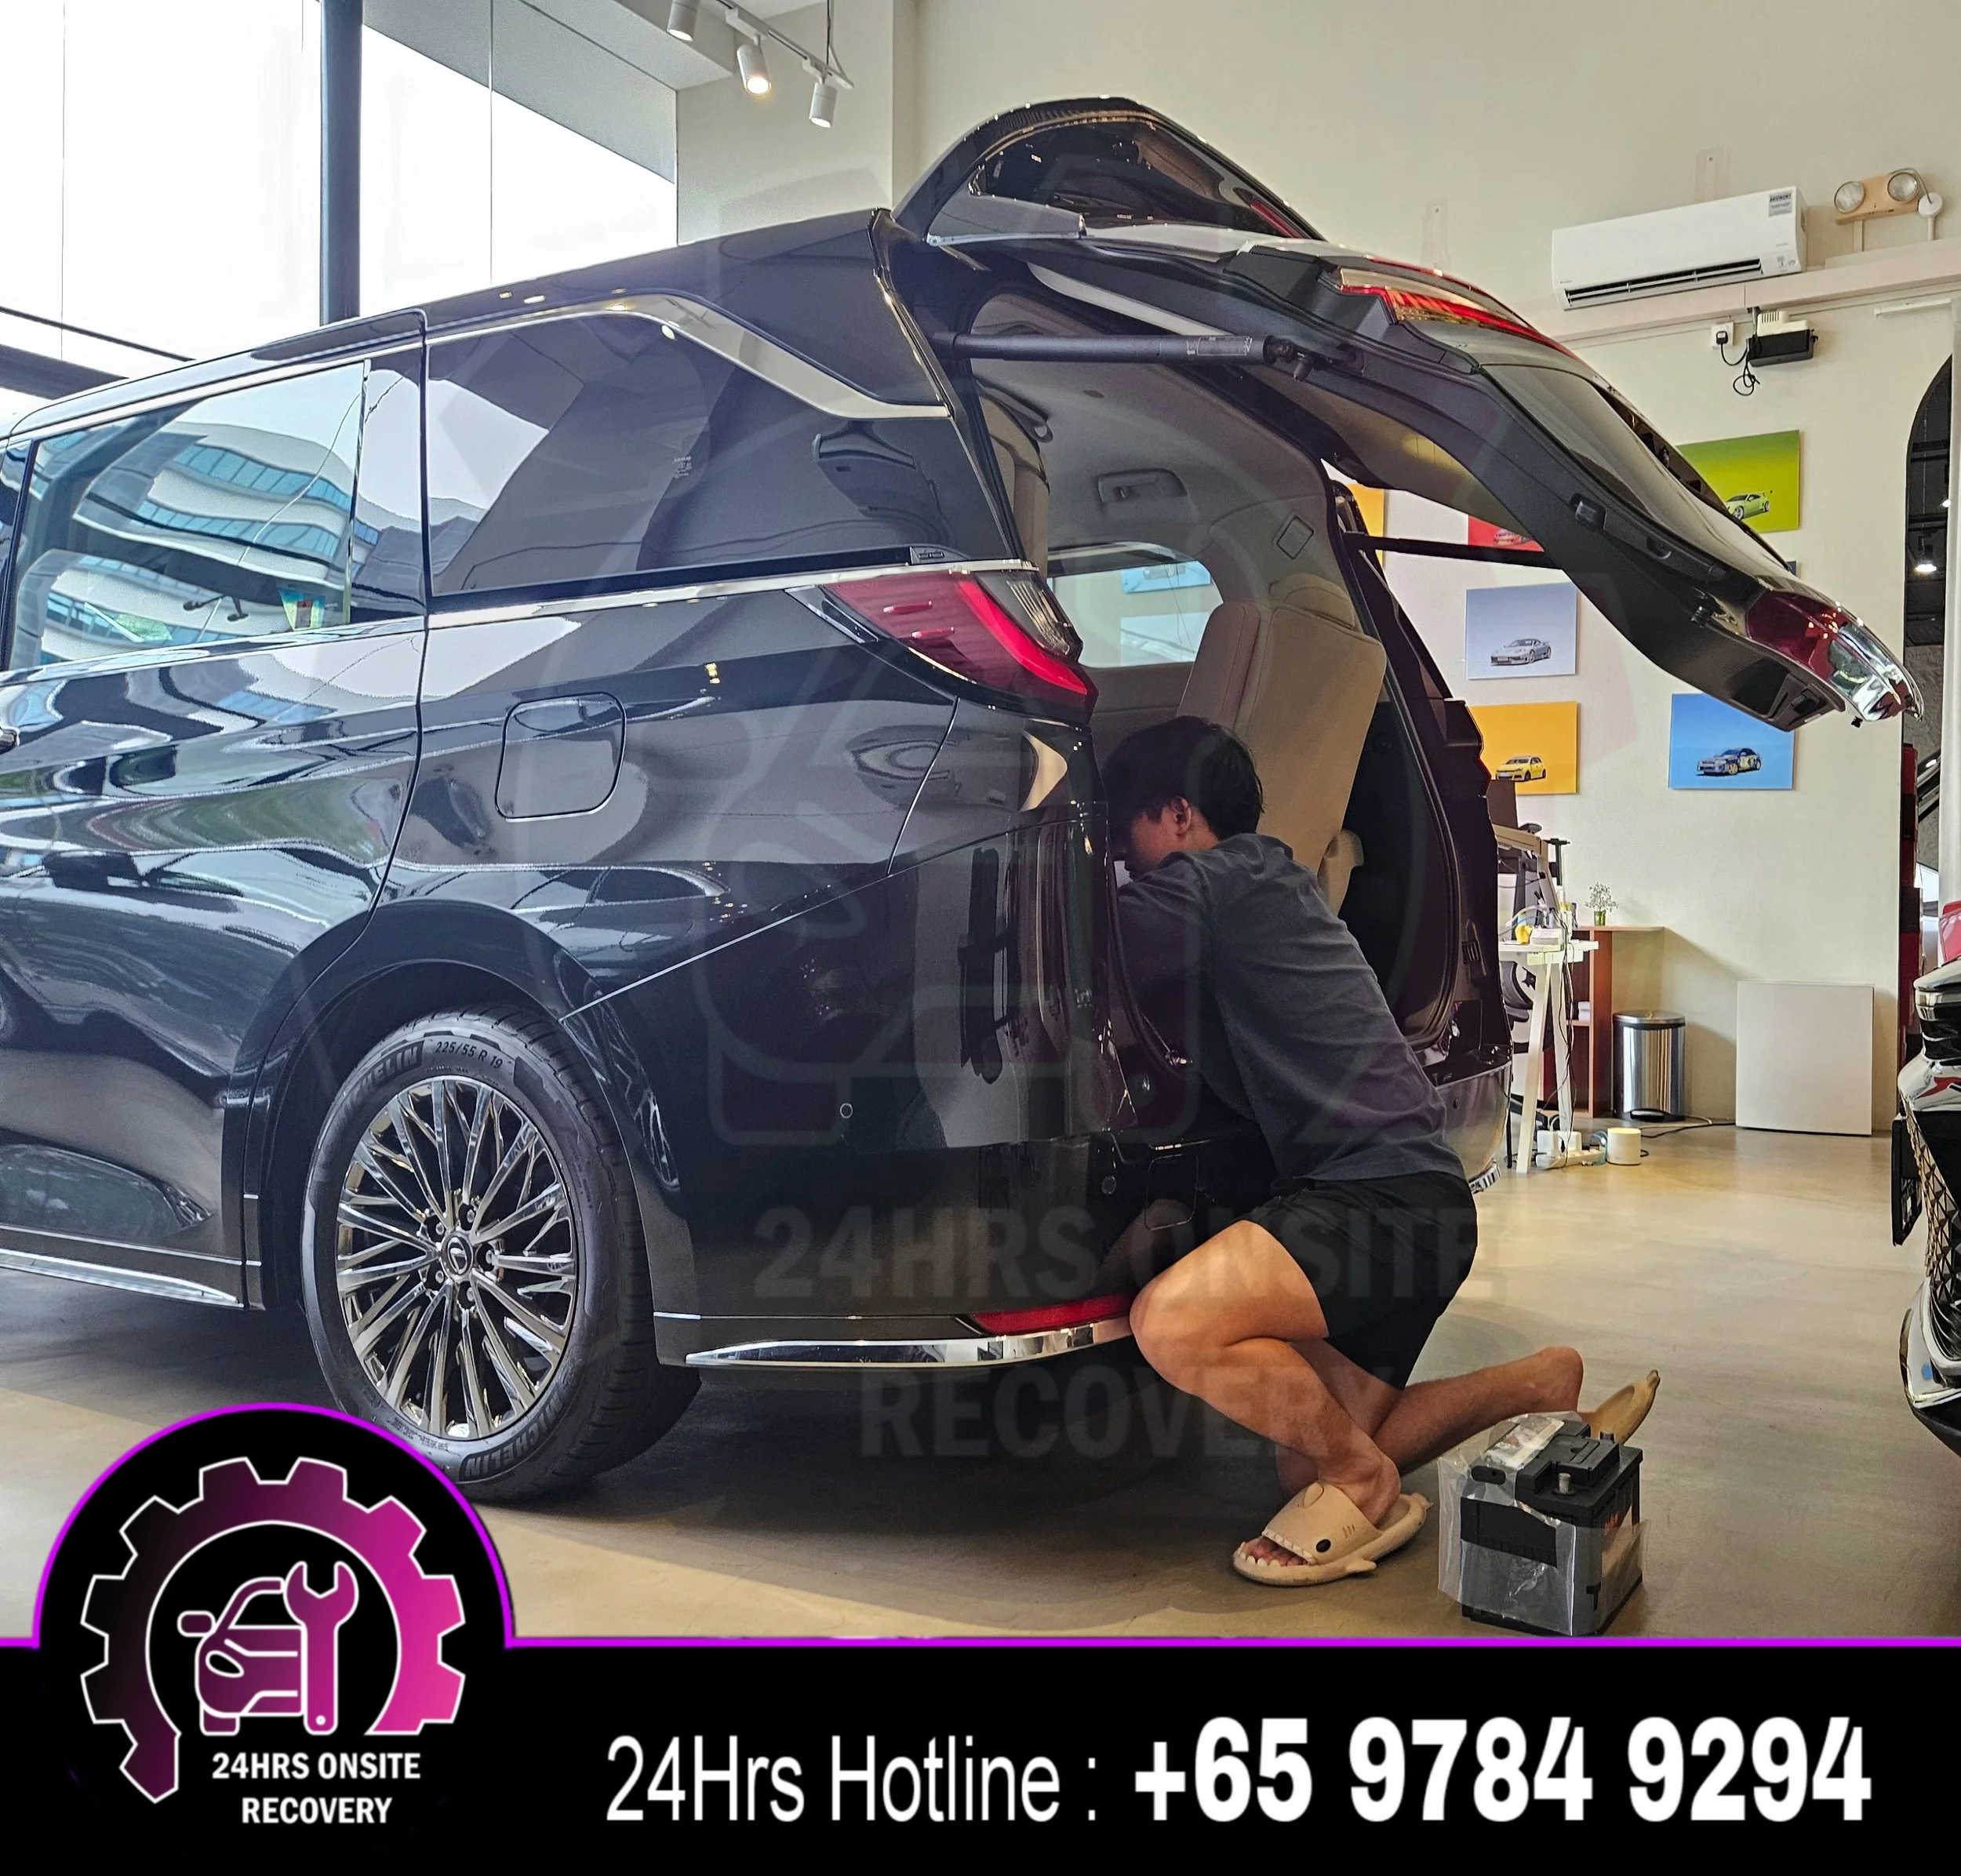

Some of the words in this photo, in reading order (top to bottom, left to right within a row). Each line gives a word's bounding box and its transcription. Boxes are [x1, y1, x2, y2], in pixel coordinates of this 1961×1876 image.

[435, 1041, 477, 1057] 225/55
[478, 1049, 488, 1062] R
[489, 1055, 504, 1070] 19
